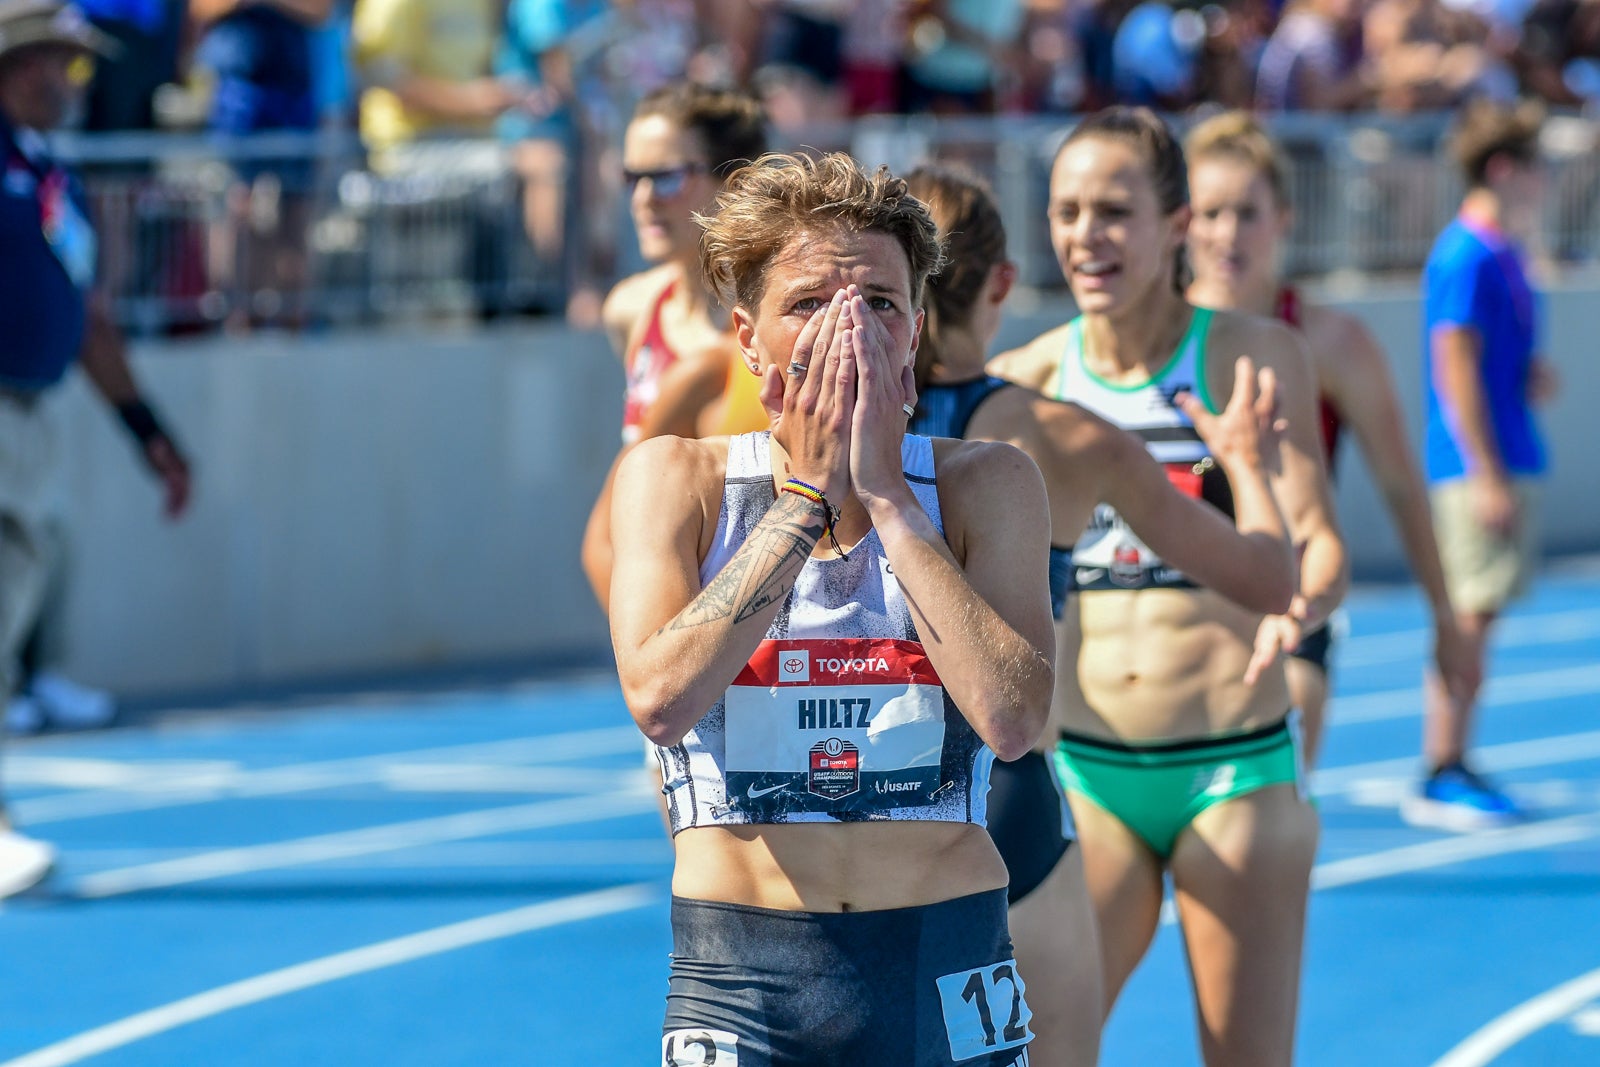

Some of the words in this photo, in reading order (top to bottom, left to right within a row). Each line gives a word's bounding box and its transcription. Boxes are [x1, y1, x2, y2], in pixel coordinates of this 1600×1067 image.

[816, 658, 889, 673] TOYOTA
[798, 698, 871, 730] HILTZ
[889, 781, 922, 792] USATF
[961, 964, 1026, 1047] 12
